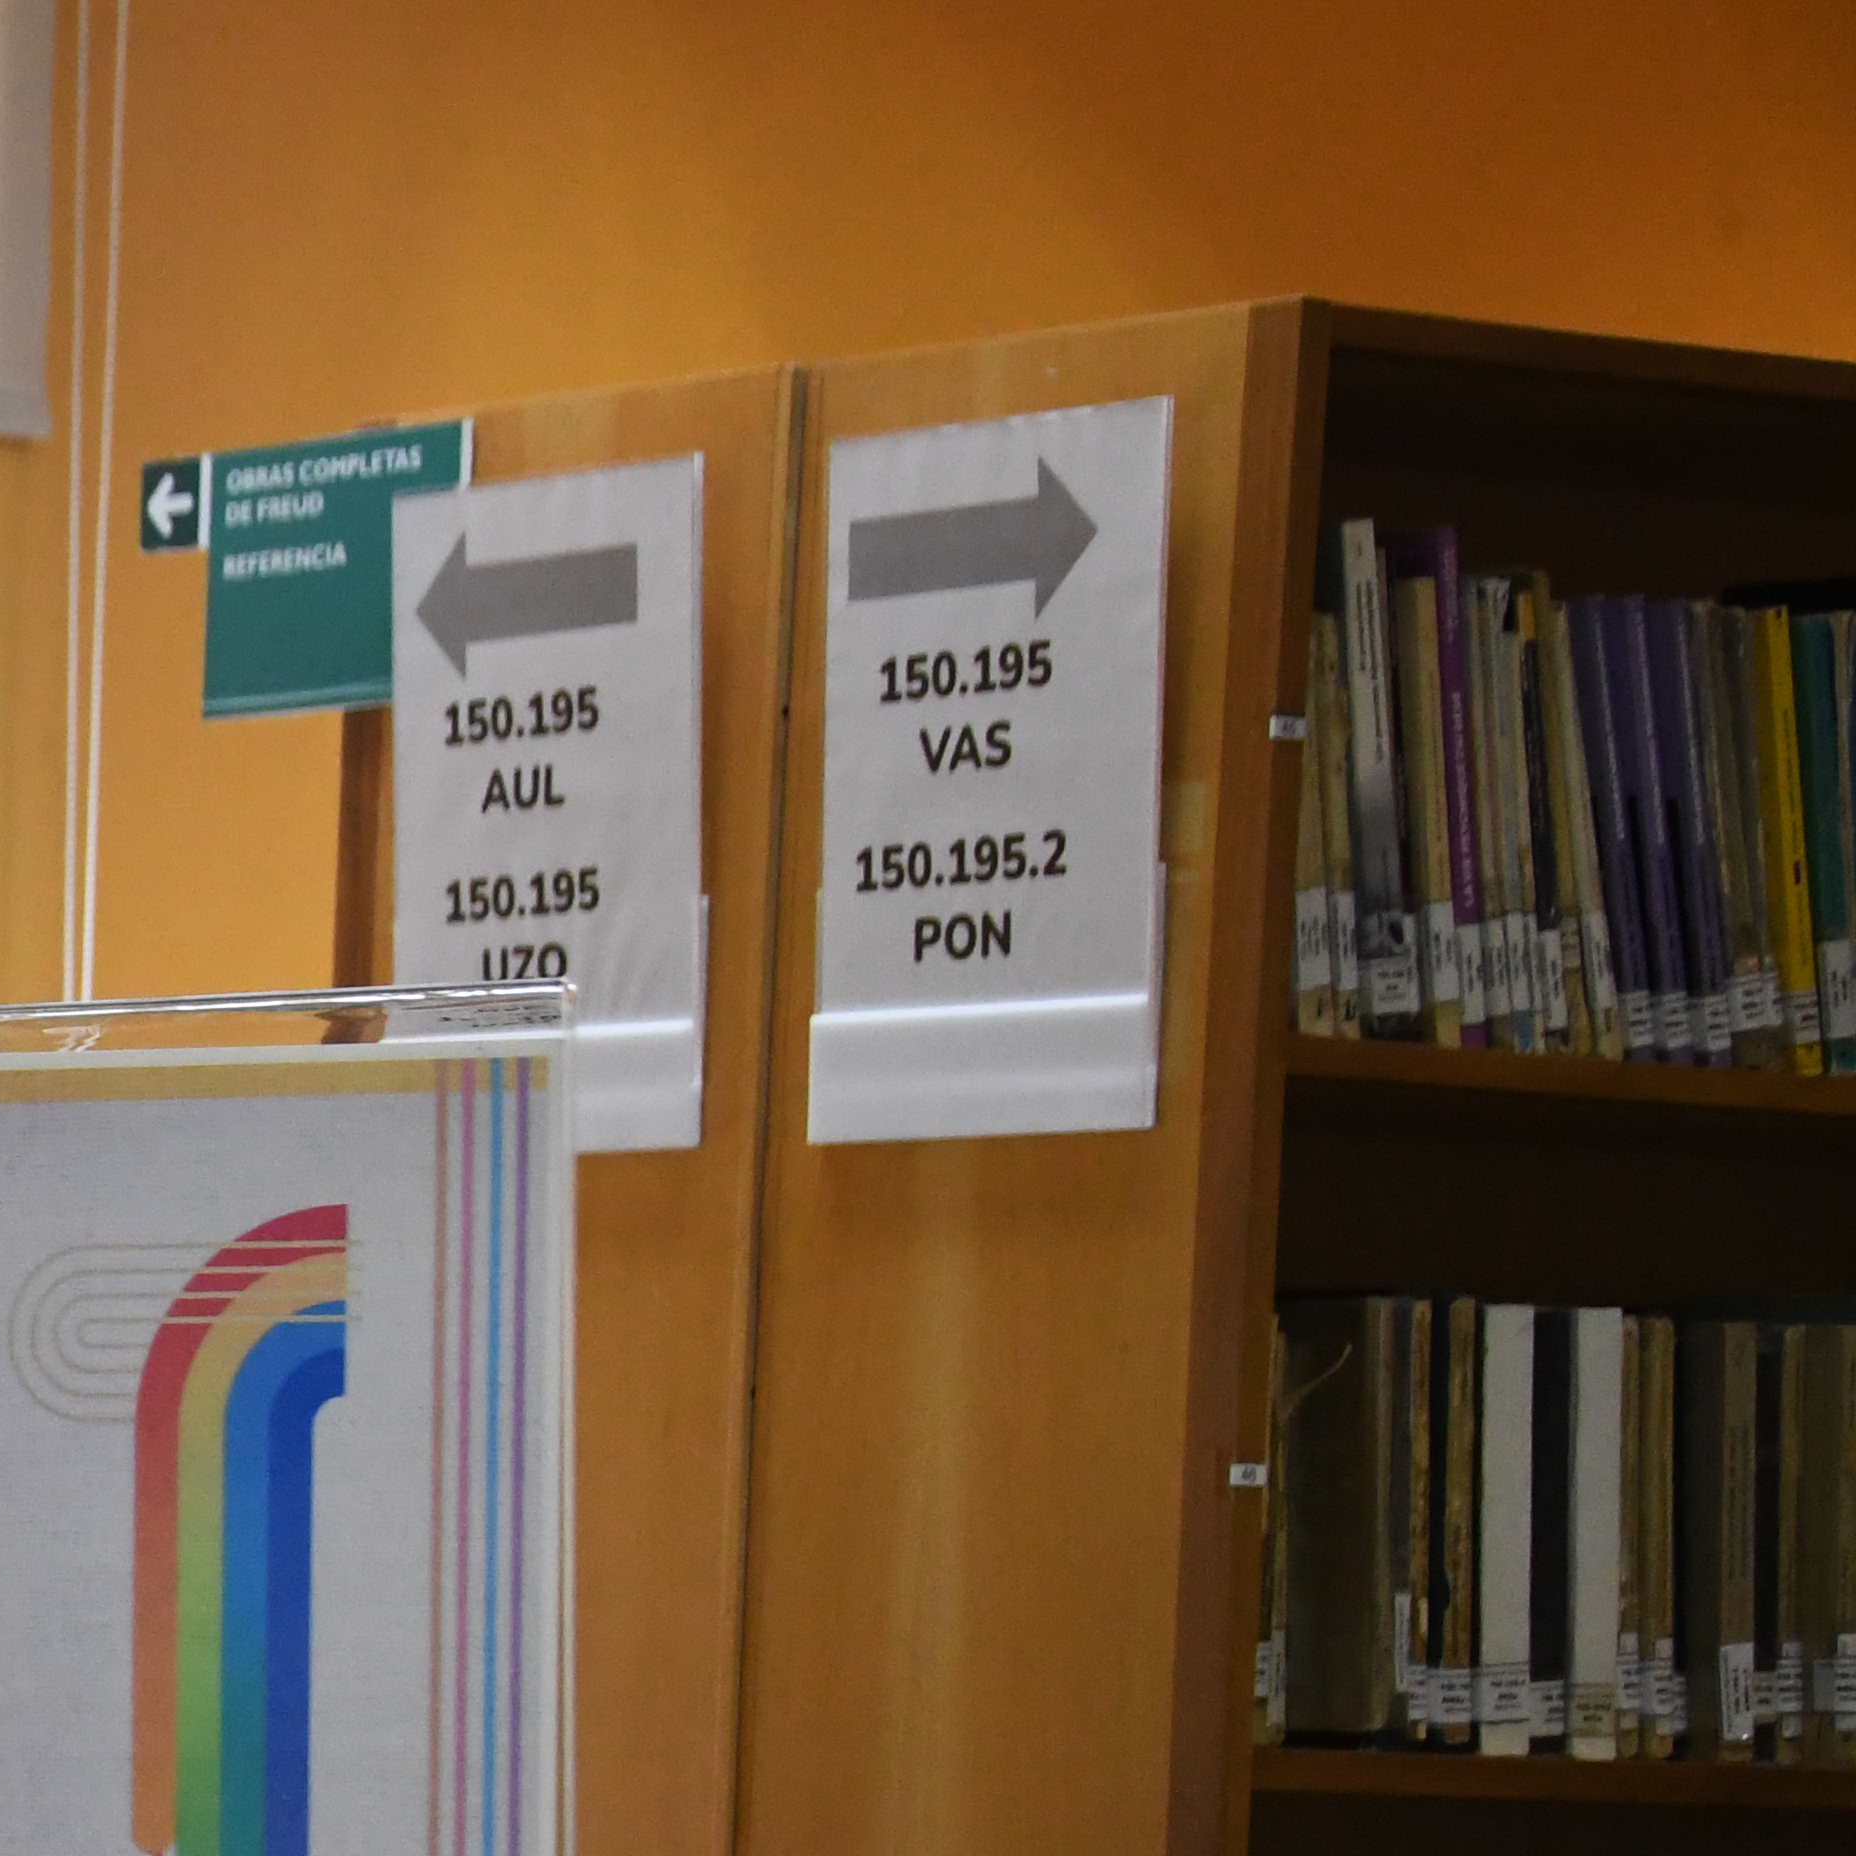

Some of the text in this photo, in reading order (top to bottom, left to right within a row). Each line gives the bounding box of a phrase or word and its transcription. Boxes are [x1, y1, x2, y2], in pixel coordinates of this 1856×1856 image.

[226, 446, 423, 494] OBRAS COMPLETAS
[225, 491, 325, 527] DE FREUD
[223, 542, 347, 580] REFERENCIA
[879, 638, 1052, 704] 150.195
[445, 685, 599, 747] 150.195
[919, 718, 1012, 774] VAS
[481, 763, 565, 814] AUL
[856, 828, 1067, 892] 150.195.2
[446, 866, 599, 924] 150.195
[482, 941, 568, 981] UZO
[914, 908, 1011, 963] PON
